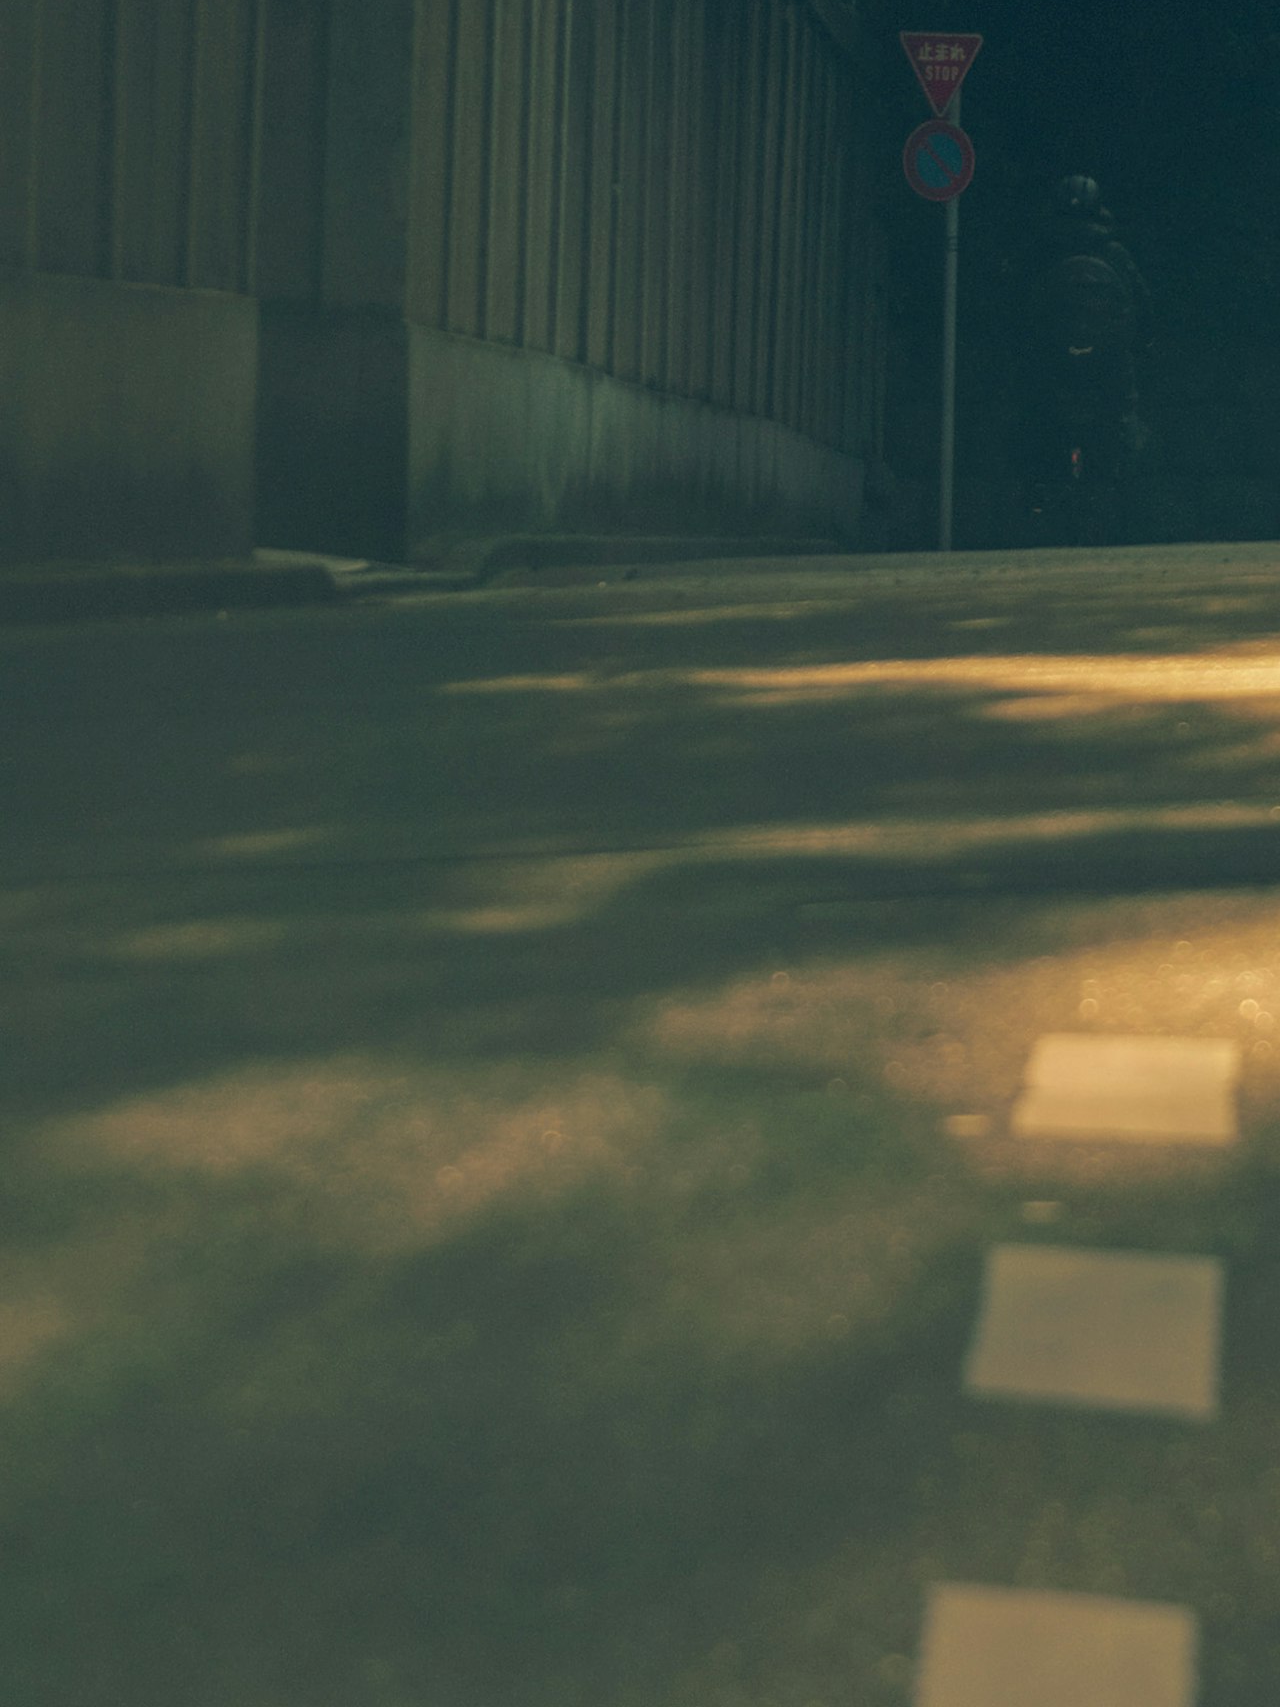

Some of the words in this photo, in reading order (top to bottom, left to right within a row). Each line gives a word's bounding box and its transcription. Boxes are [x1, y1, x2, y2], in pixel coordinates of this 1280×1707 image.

[918, 42, 966, 61] 止まれ
[925, 65, 959, 81] STOP
